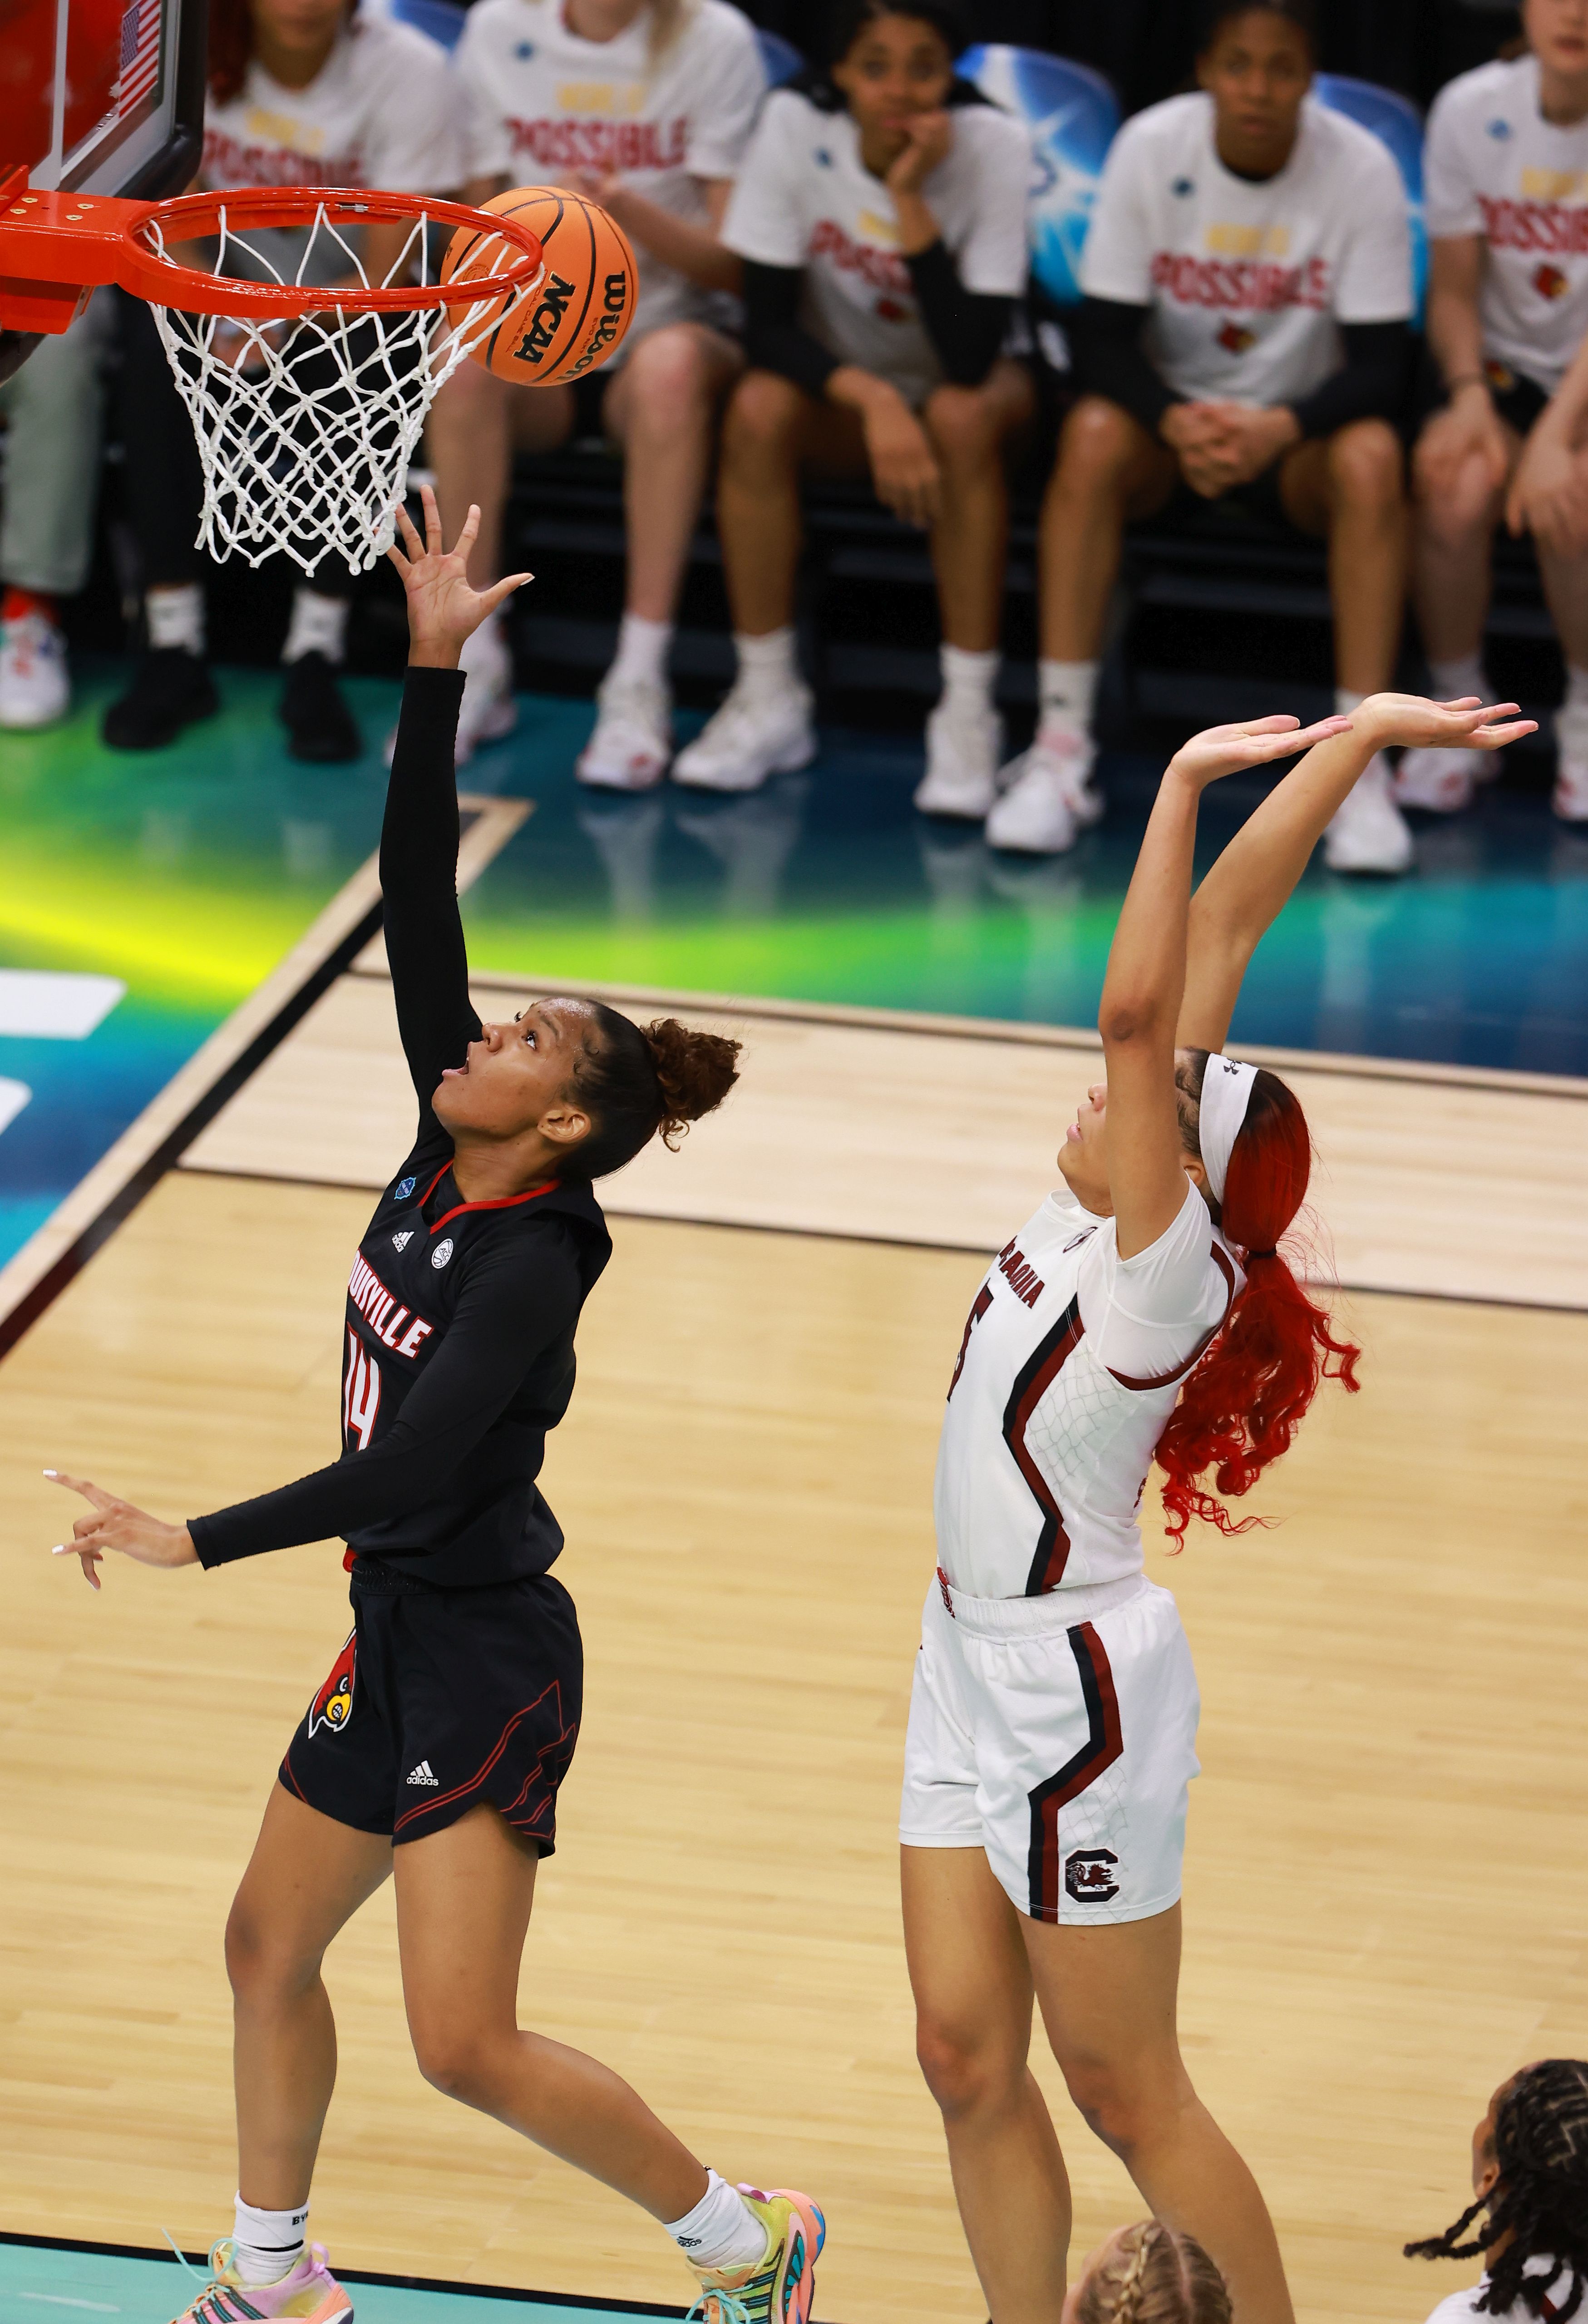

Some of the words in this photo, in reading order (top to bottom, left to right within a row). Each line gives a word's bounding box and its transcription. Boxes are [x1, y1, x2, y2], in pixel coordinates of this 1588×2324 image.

[512, 271, 576, 364] NCAA
[439, 1247, 449, 1261] ACC
[406, 1775, 439, 1786] adidas
